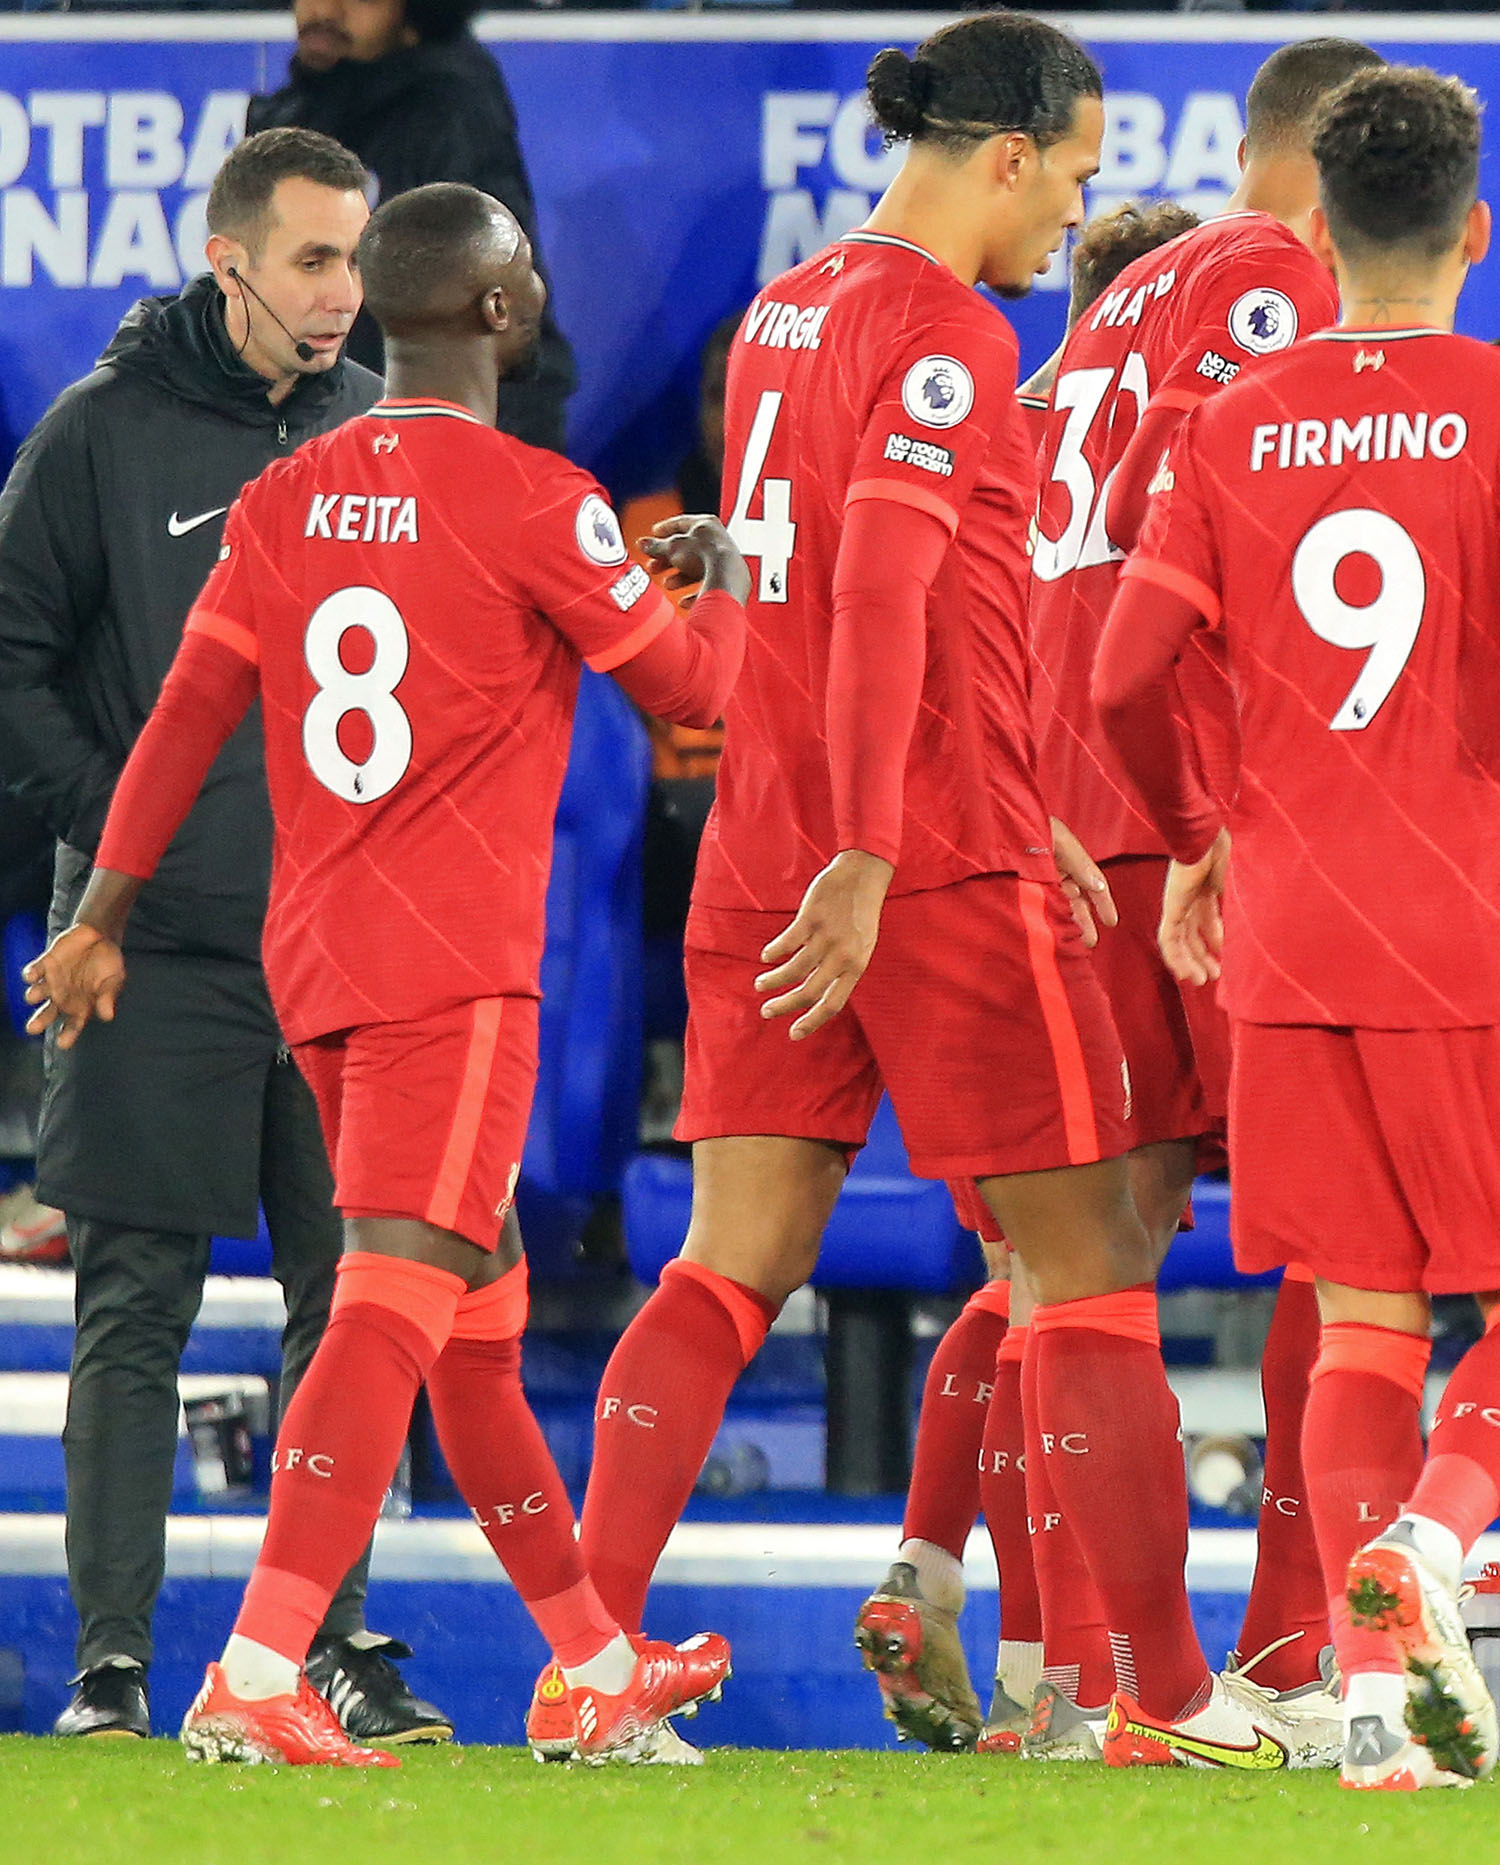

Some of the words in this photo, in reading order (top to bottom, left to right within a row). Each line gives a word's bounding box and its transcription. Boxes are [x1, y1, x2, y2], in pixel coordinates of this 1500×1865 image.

[744, 299, 830, 350] VIRGIL
[886, 433, 911, 451] No
[911, 441, 950, 463] room
[1250, 412, 1467, 472] FIRMINO
[304, 494, 419, 542] KEITA
[726, 391, 797, 603] 4
[1292, 508, 1426, 731] 9
[303, 586, 413, 804] 8
